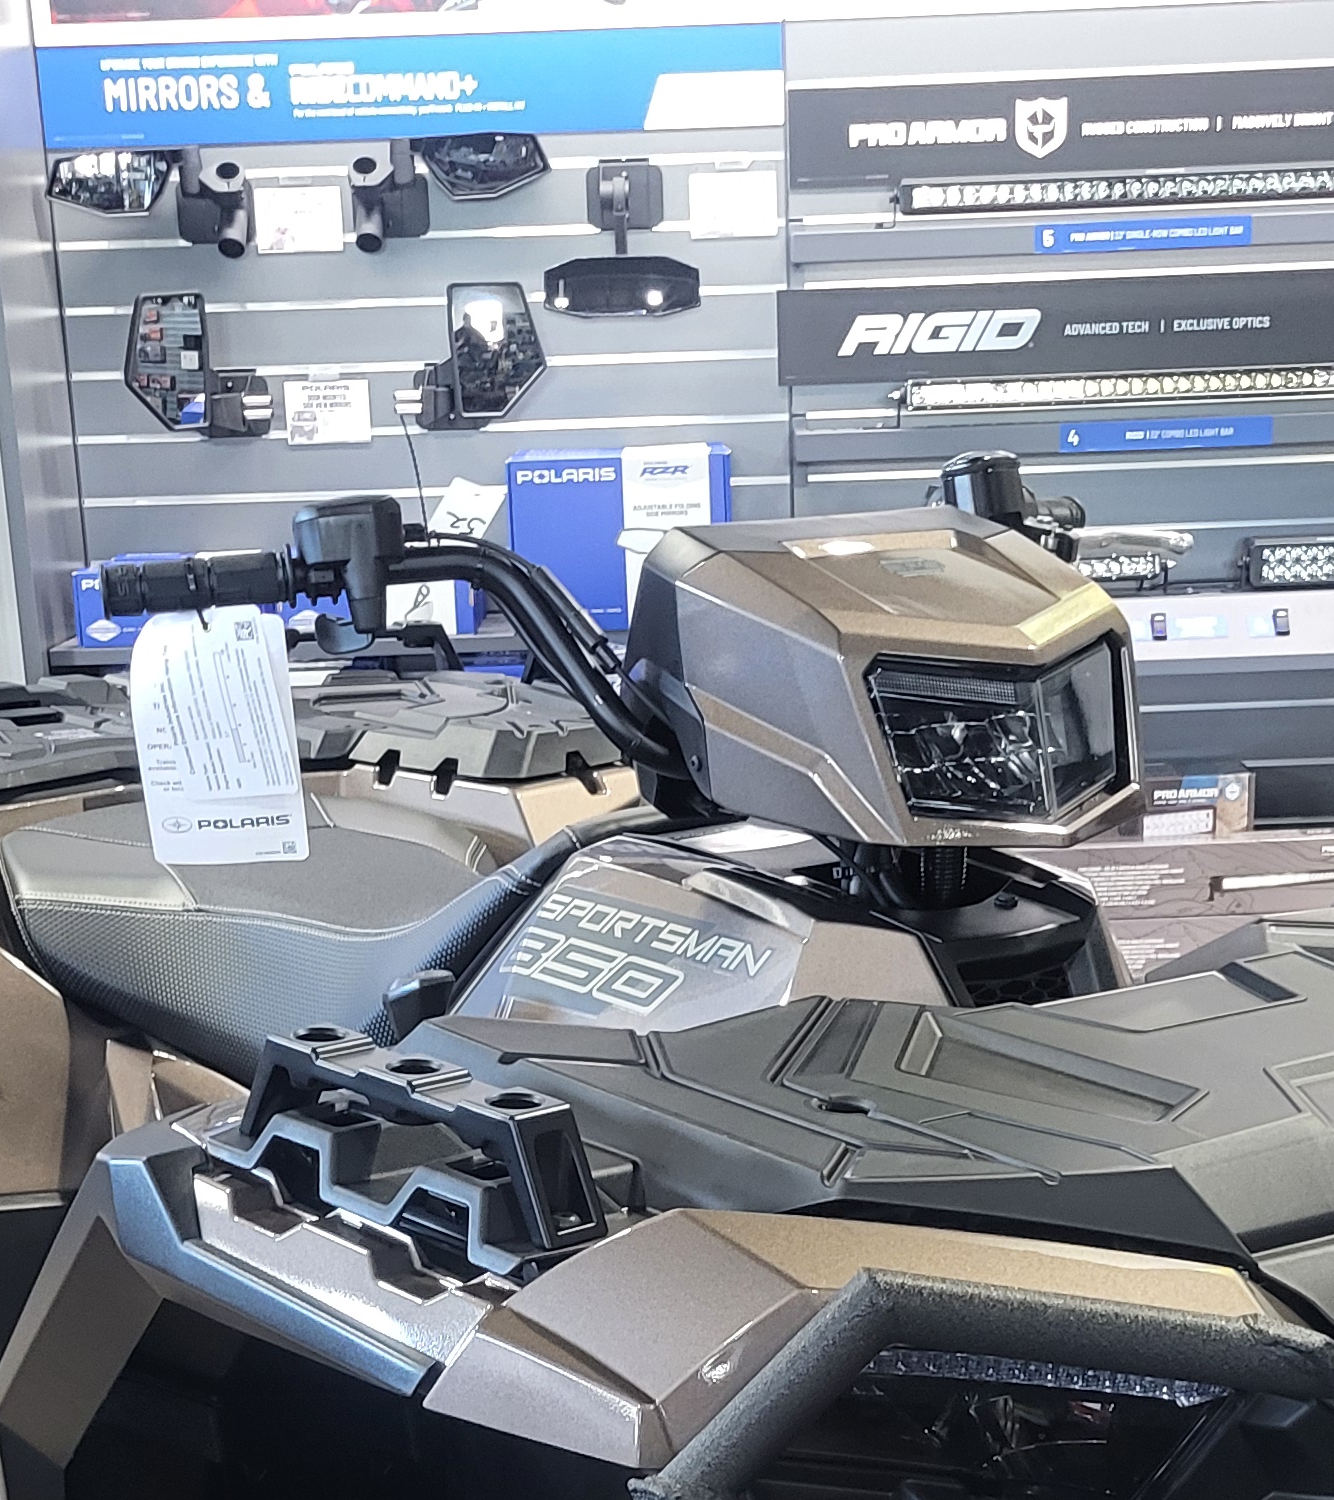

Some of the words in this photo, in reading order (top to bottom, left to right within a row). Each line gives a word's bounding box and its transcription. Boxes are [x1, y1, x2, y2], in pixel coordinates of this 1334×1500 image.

[104, 74, 240, 112] MIRRORS
[247, 73, 271, 108] &
[848, 121, 907, 148] PRO
[907, 117, 1008, 146] ARMOR
[837, 308, 1042, 357] RIGID
[1064, 321, 1120, 337] ADVANCED
[1122, 320, 1150, 335] TECH
[1173, 316, 1231, 333] EXCLUSIVE
[1232, 315, 1272, 330] OPTICS
[1067, 429, 1080, 446] 4
[517, 467, 616, 485] POLARIS
[633, 503, 671, 512] ADJUSTABLE
[1154, 789, 1177, 801] PRO
[1178, 788, 1218, 800] ARMOR
[198, 814, 290, 831] POLARIS
[537, 893, 772, 977] SPORTSMAN
[499, 926, 685, 1016] 850
